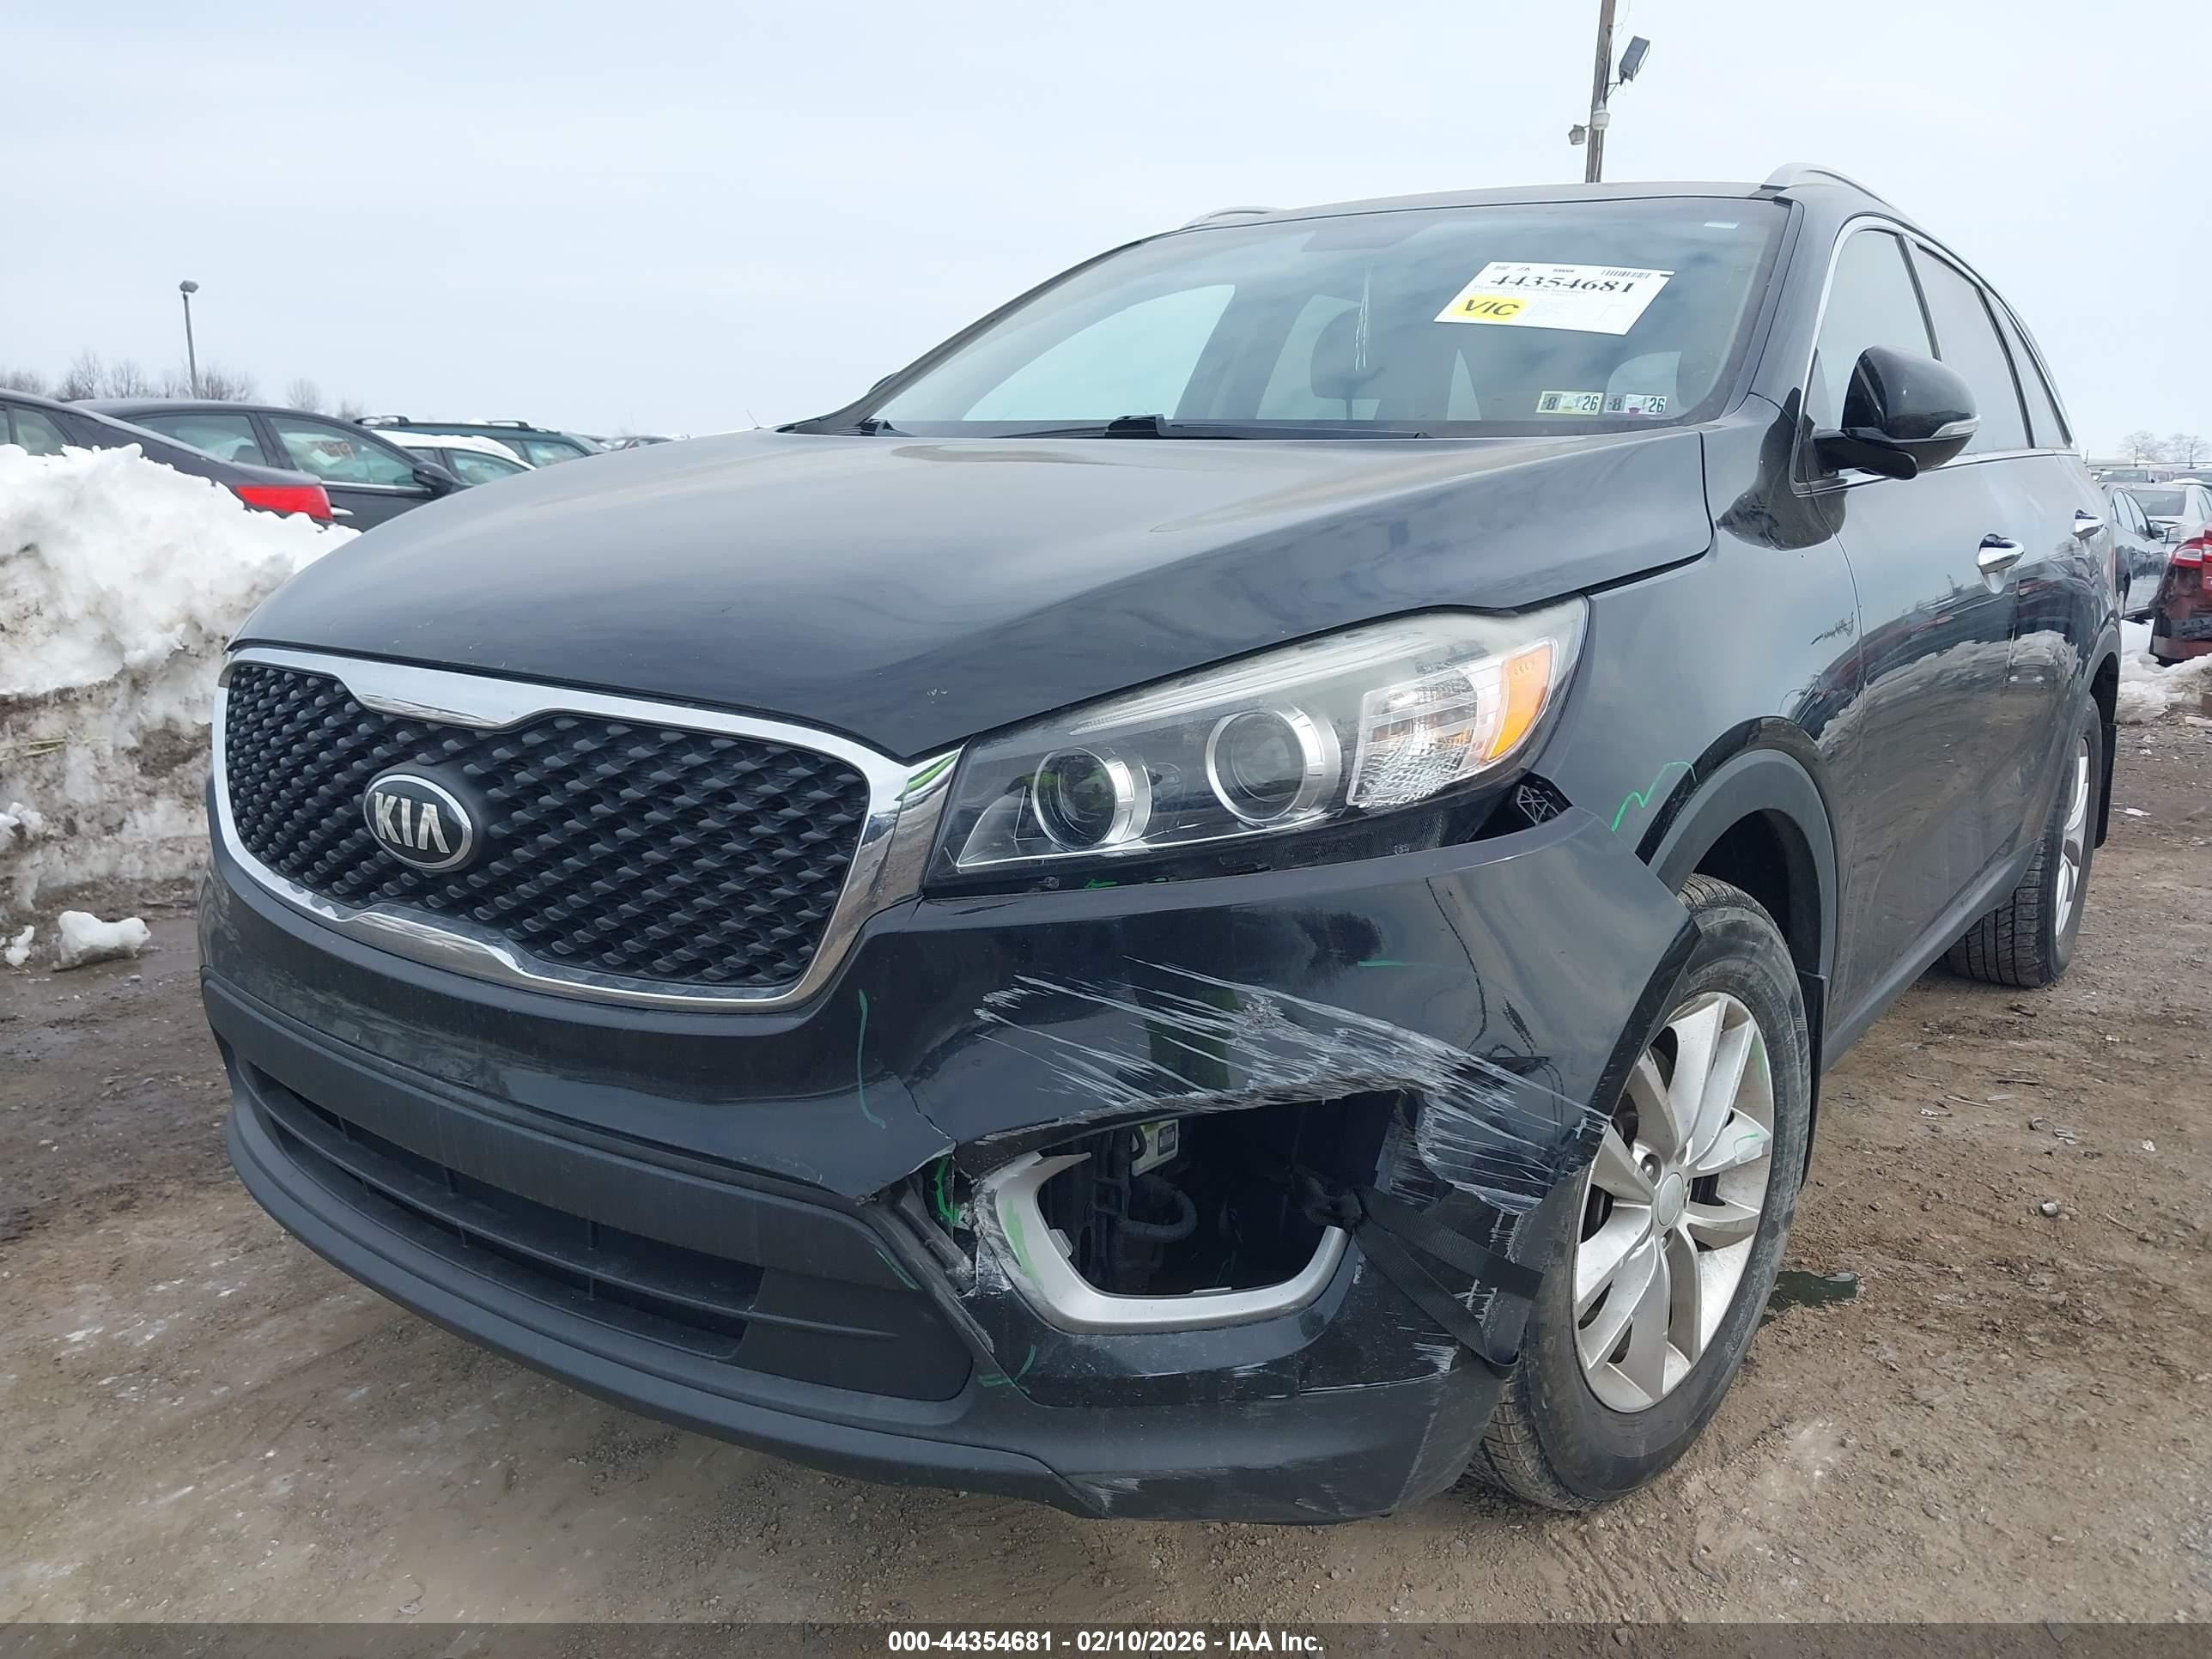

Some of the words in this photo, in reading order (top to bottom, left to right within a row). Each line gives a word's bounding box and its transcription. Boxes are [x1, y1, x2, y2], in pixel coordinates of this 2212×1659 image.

[1491, 275, 1635, 293] 44354681
[1464, 299, 1519, 316] VIC
[1582, 395, 1599, 410] 26
[1648, 397, 1665, 413] 26
[374, 792, 451, 854] KIA
